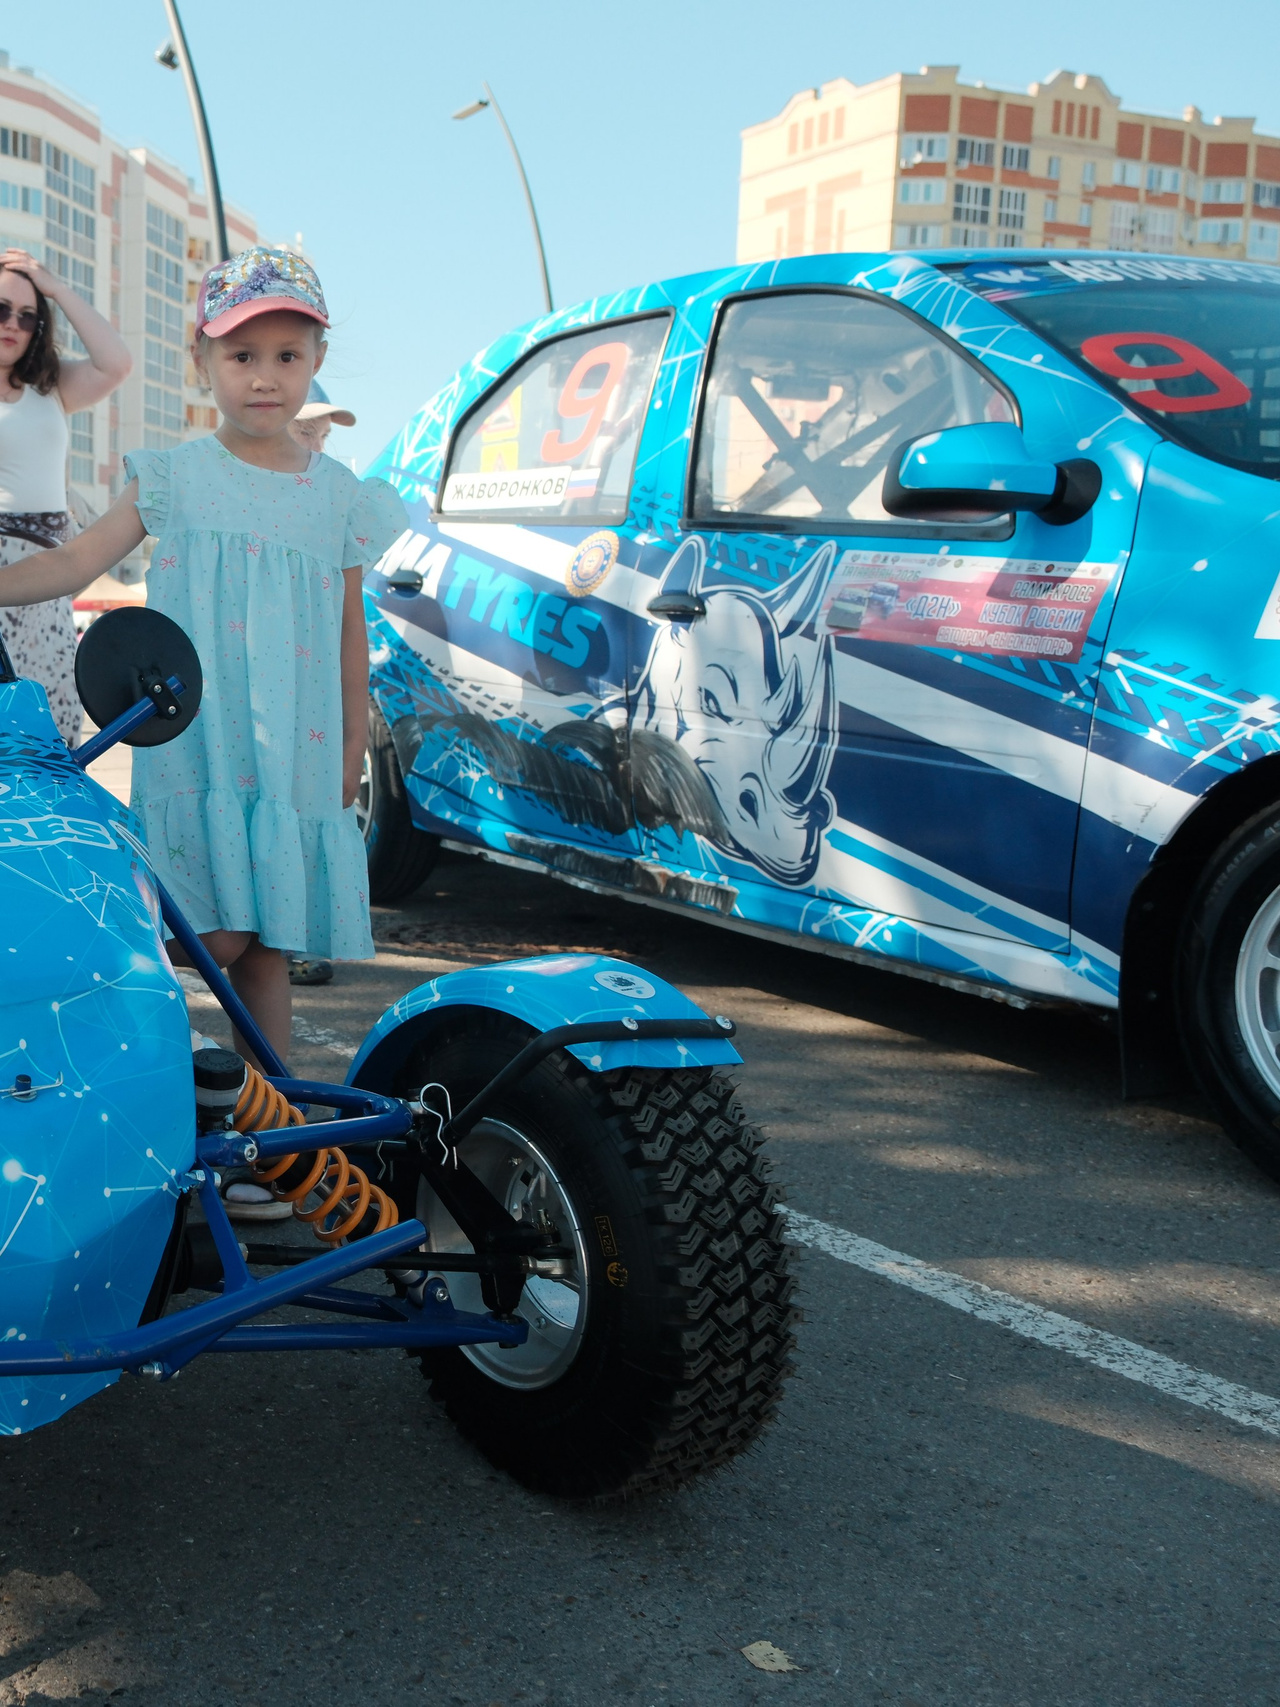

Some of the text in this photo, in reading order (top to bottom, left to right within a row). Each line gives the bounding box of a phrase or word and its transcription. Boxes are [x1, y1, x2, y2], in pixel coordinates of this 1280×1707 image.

[1080, 331, 1252, 413] 9
[540, 341, 629, 463] 9
[451, 477, 566, 501] ЖАВОРОНКОВ
[1010, 580, 1096, 602] РАЛЛИ-КРОСС
[443, 552, 603, 670] TYRES
[978, 602, 1086, 632] КУБОК РОССИИ
[936, 626, 1074, 656] АВТОДРОМ «ВЫСОКАЯ ГОРА»
